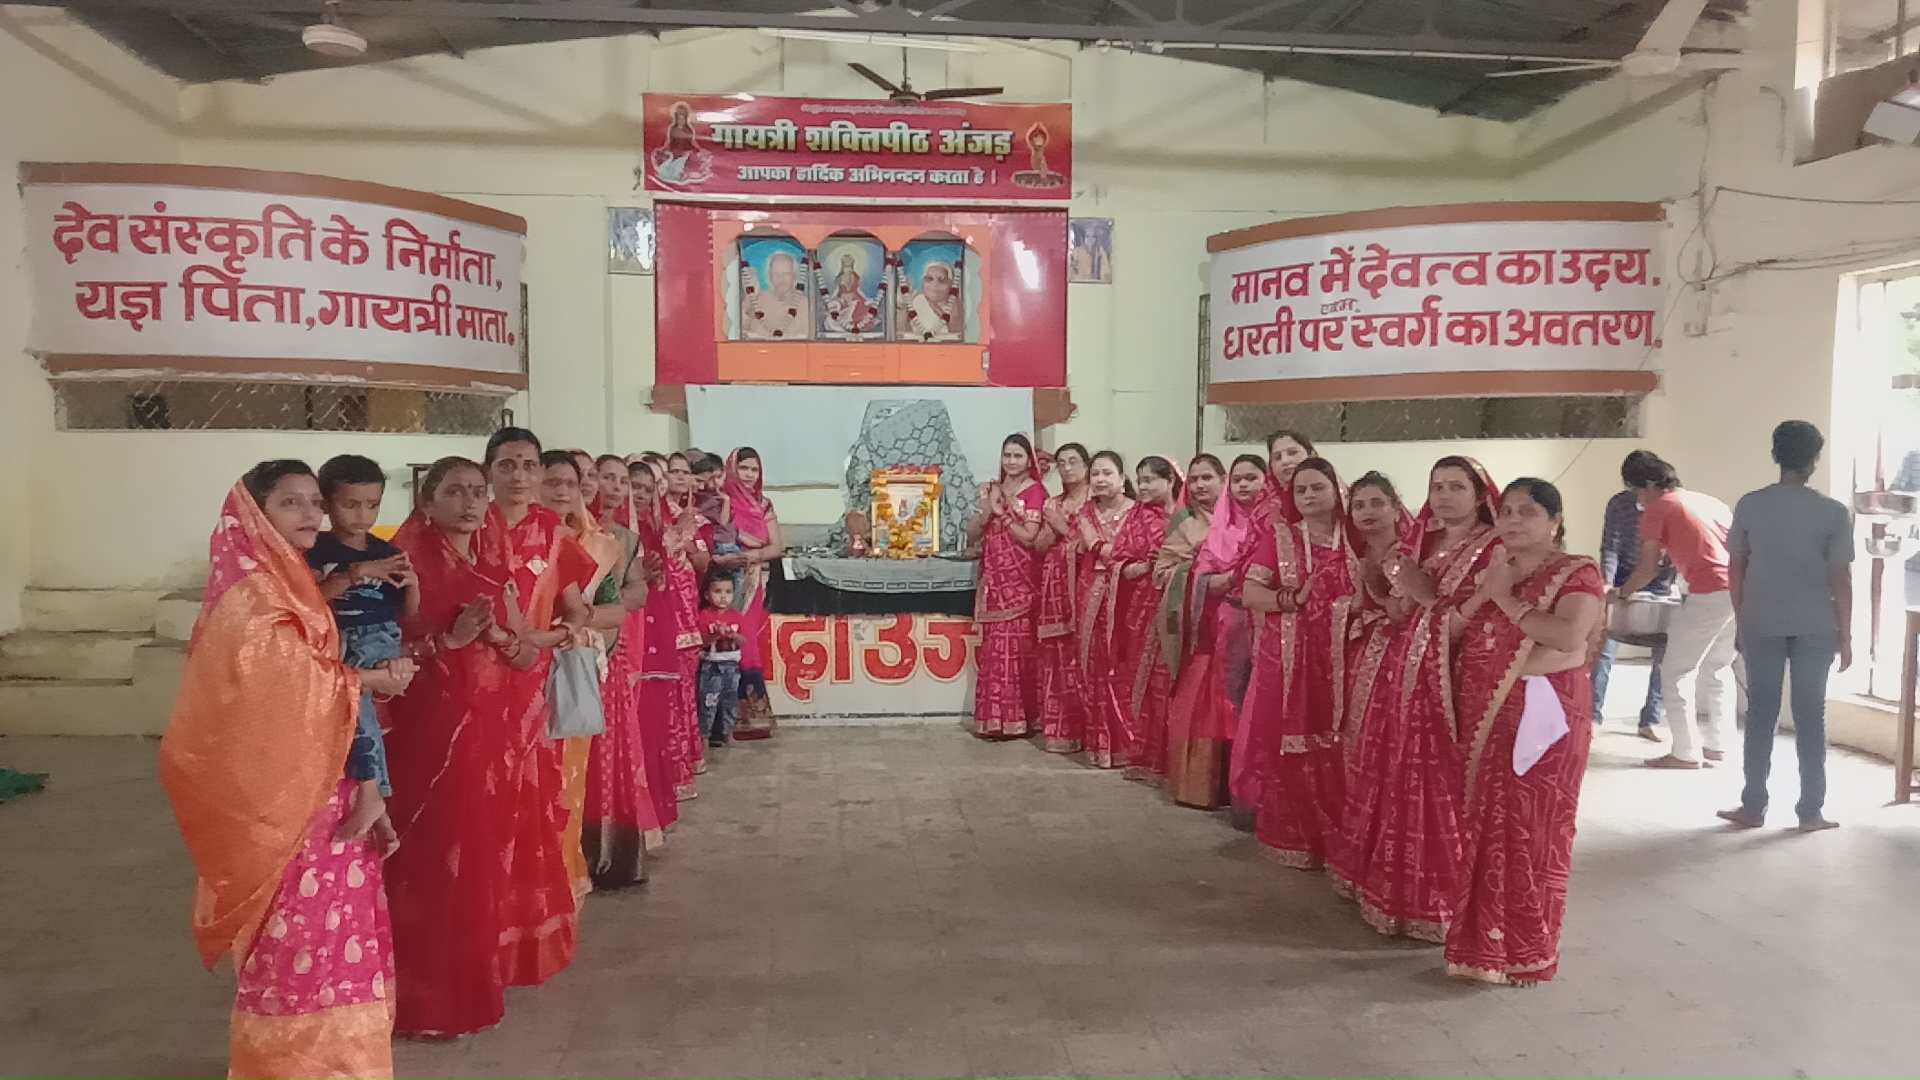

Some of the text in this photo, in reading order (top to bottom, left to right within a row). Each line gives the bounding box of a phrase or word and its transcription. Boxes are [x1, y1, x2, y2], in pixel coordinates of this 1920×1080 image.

[710, 119, 1013, 161] गायत्री शक्तिपीठ अंजड़
[737, 165, 792, 181] आपका
[796, 163, 845, 181] हार्दिक
[849, 164, 926, 184] अभिनन्दन
[928, 169, 970, 184] करता
[53, 201, 503, 292] देव संस्कृति के निर्माता,
[1231, 263, 1314, 305] मानव
[1319, 246, 1356, 294] में
[1357, 243, 1492, 300] देवत्व
[1495, 249, 1557, 286] का
[75, 280, 169, 332] यज्ञ
[1223, 305, 1296, 361] धरती
[1297, 315, 1349, 352] पर
[1350, 294, 1443, 349] स्वर्ग
[1444, 310, 1502, 347] का
